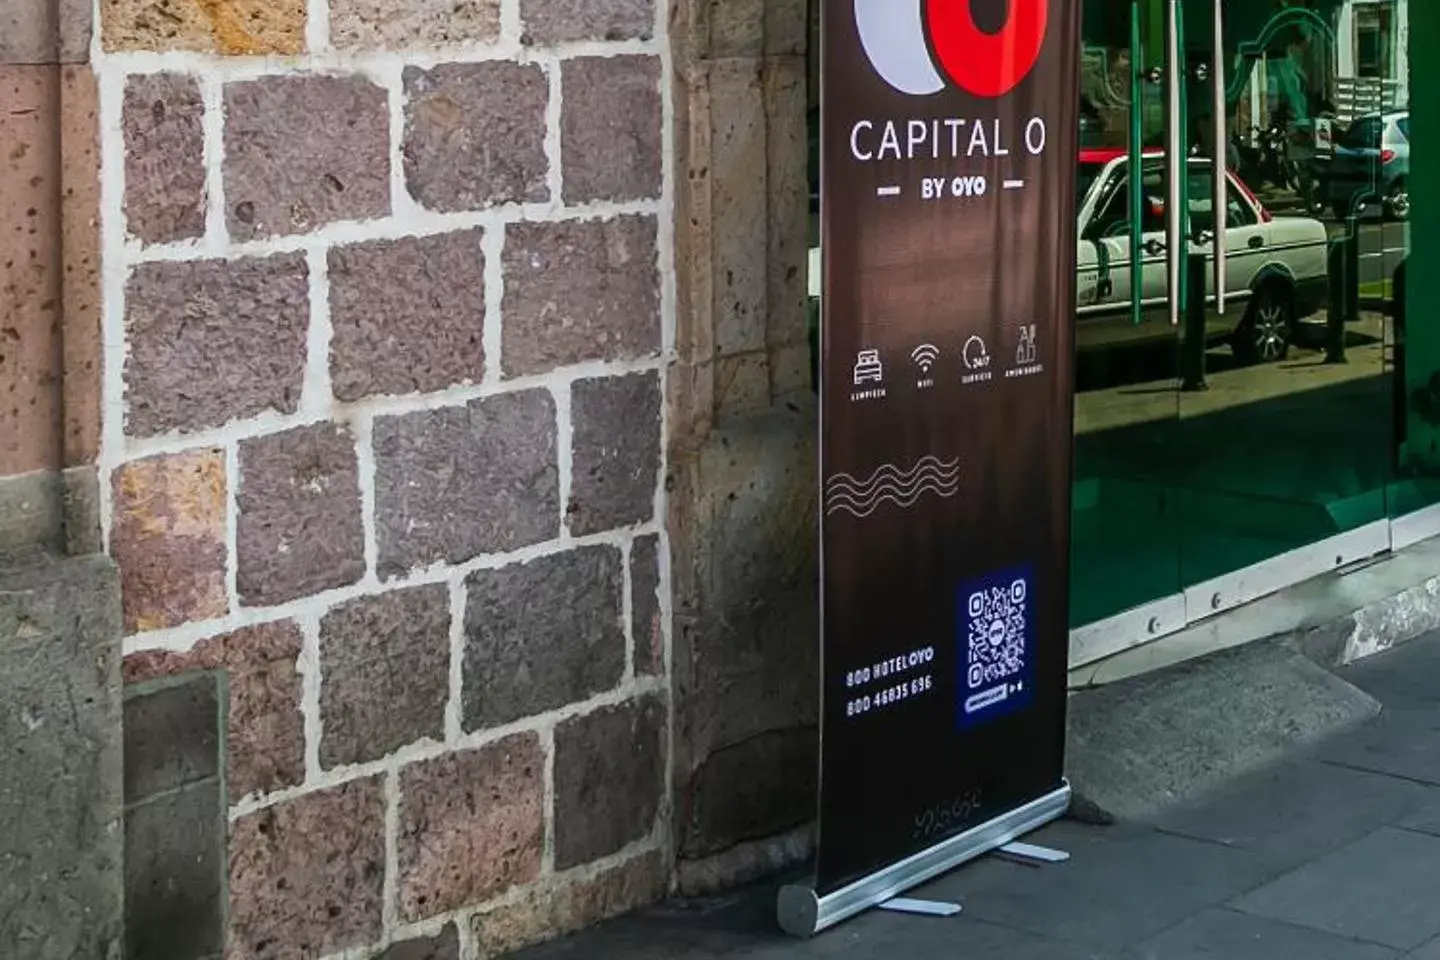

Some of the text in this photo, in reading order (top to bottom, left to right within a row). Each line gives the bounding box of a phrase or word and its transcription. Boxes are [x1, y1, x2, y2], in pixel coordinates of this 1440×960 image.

[850, 116, 1047, 161] CAPITAL O
[921, 175, 987, 199] BY OYO
